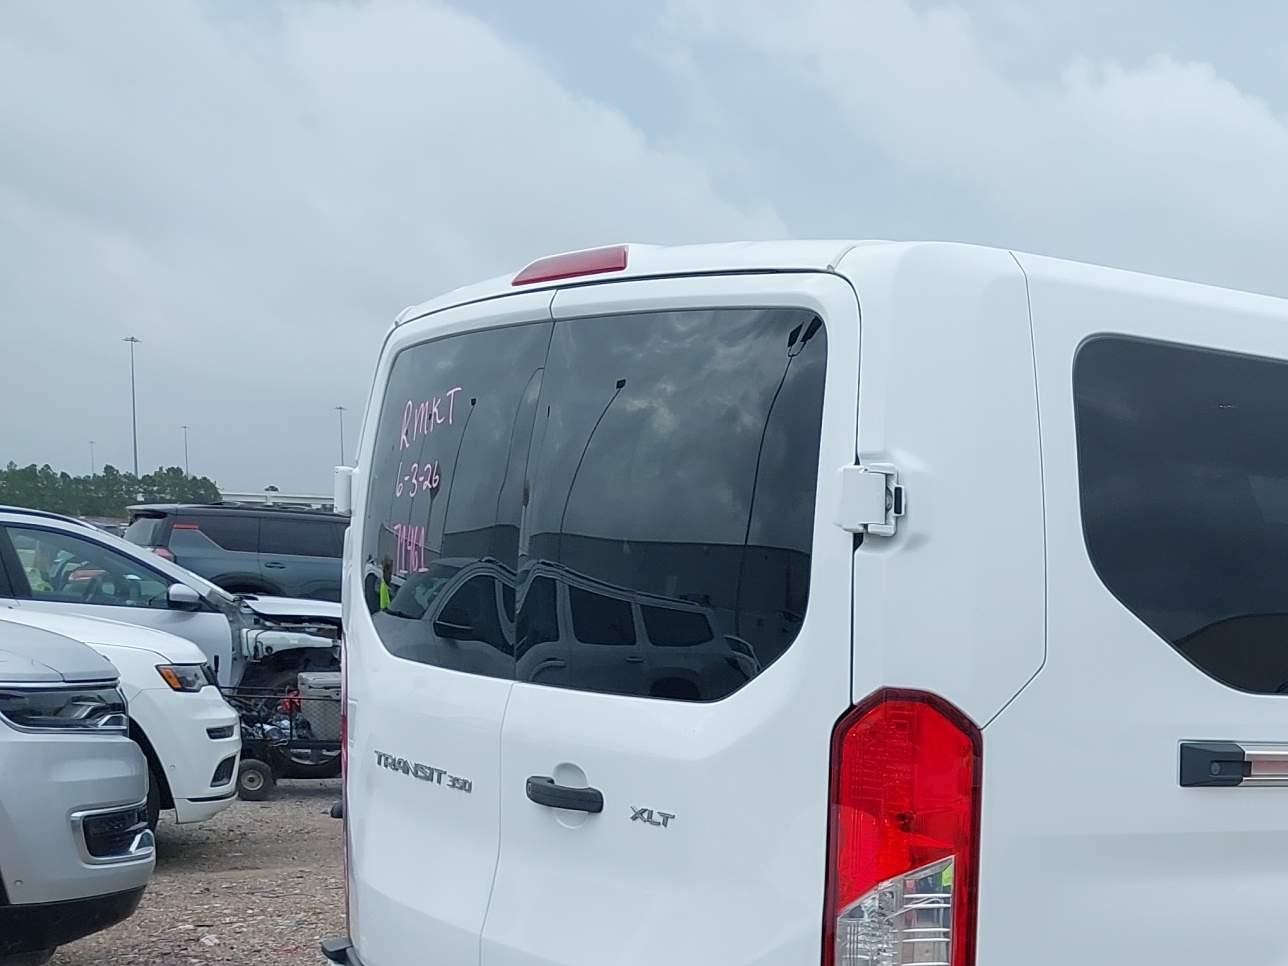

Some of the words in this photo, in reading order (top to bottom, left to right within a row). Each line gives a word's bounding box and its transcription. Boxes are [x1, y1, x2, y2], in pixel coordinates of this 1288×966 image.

[400, 387, 462, 450] RMKT
[395, 460, 440, 497] 6-3-26
[374, 750, 447, 785] TRANSIT
[447, 774, 473, 793] 350
[629, 806, 676, 828] XLT
